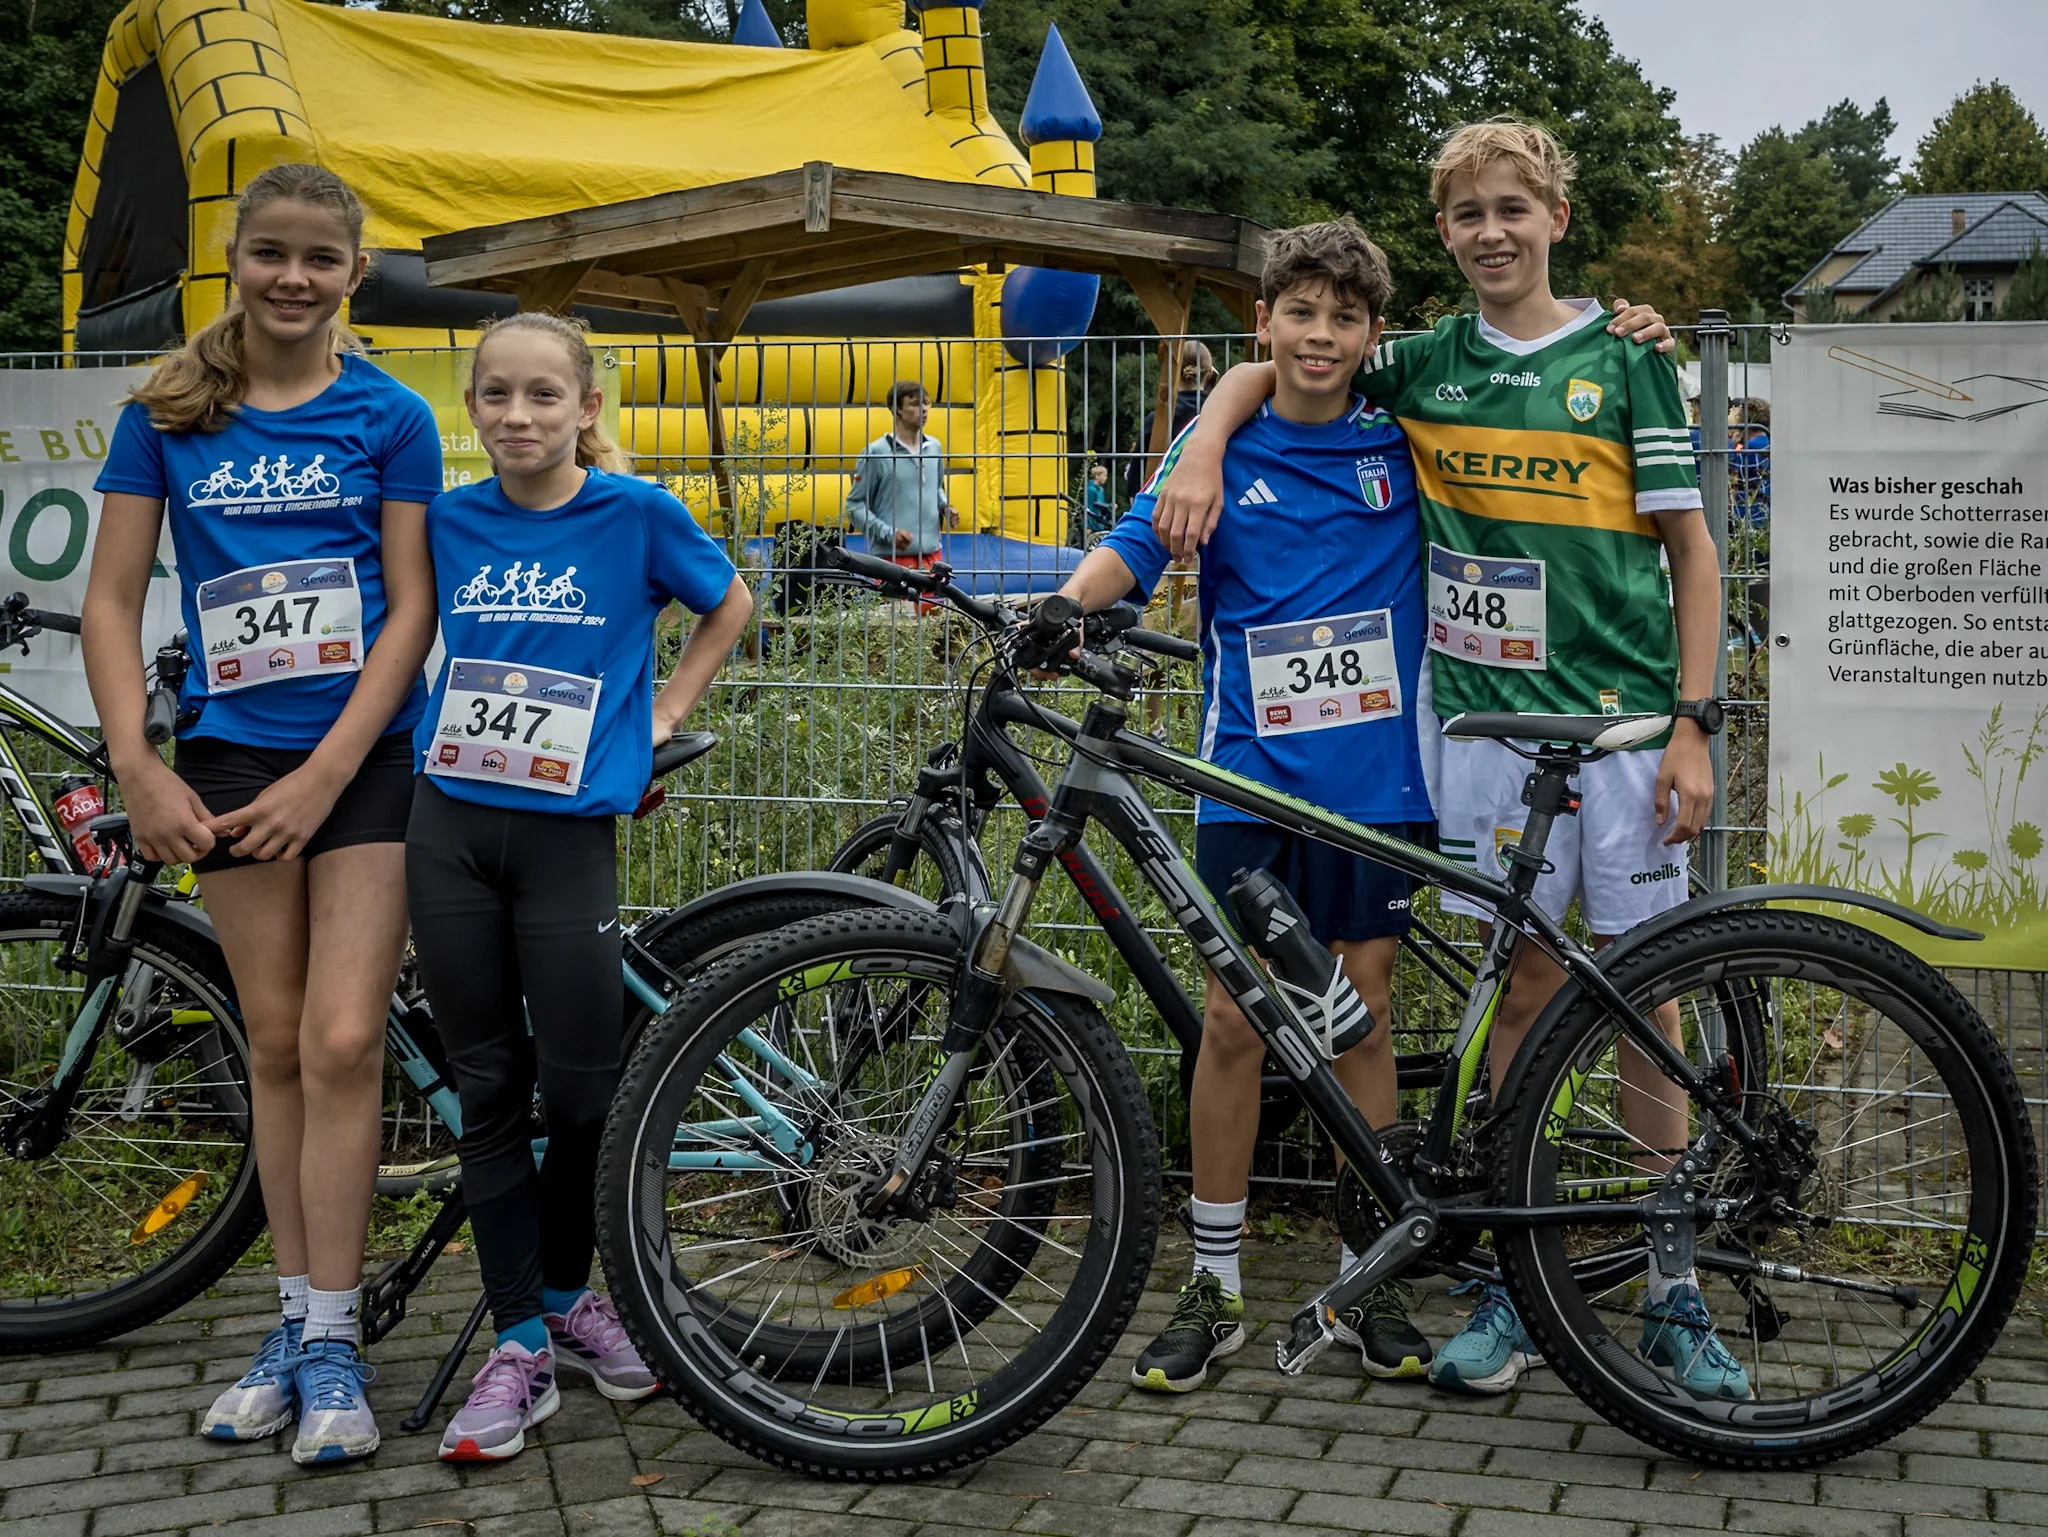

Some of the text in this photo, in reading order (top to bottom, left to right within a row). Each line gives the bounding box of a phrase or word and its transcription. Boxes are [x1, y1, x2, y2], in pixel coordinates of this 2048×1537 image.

[1360, 467, 1386, 479] ITALIA
[1435, 449, 1591, 484] KERRY
[1829, 477, 2022, 499] Was bisher geschah
[223, 496, 363, 516] RUN AND BIKE MICHENDORF 2024
[1830, 504, 1849, 520] Es
[1855, 504, 1913, 521] wurde
[1829, 530, 1917, 552] gebracht,
[1924, 532, 1979, 548] sowie
[1985, 531, 2014, 549] die
[1830, 557, 2041, 580] und die großen Fläche
[301, 574, 346, 588] gewog
[1492, 574, 1534, 586] gewog
[1830, 585, 1860, 601] mit
[1866, 584, 1974, 603] Oberboden
[1446, 585, 1507, 629] 348
[235, 596, 320, 645] 347
[528, 613, 582, 625] MICHENDORF
[582, 615, 607, 626] 2024
[1829, 611, 2048, 634] glattgezogen. So entsta
[1344, 625, 1381, 641] gewog
[1464, 640, 1482, 656] bbg
[1829, 638, 1938, 659] Grünfläche,
[1945, 640, 1974, 657] die
[1980, 640, 2023, 658] aber
[268, 657, 296, 669] bbg
[1286, 649, 1363, 694] 348
[1828, 665, 2047, 689] Veranstaltungen nutzb
[539, 685, 586, 705] gewog
[465, 697, 552, 744] 347
[1269, 708, 1288, 717] REWE
[1319, 707, 1342, 718] bbg
[481, 758, 508, 773] bbg
[1141, 857, 1318, 1082] BULLS
